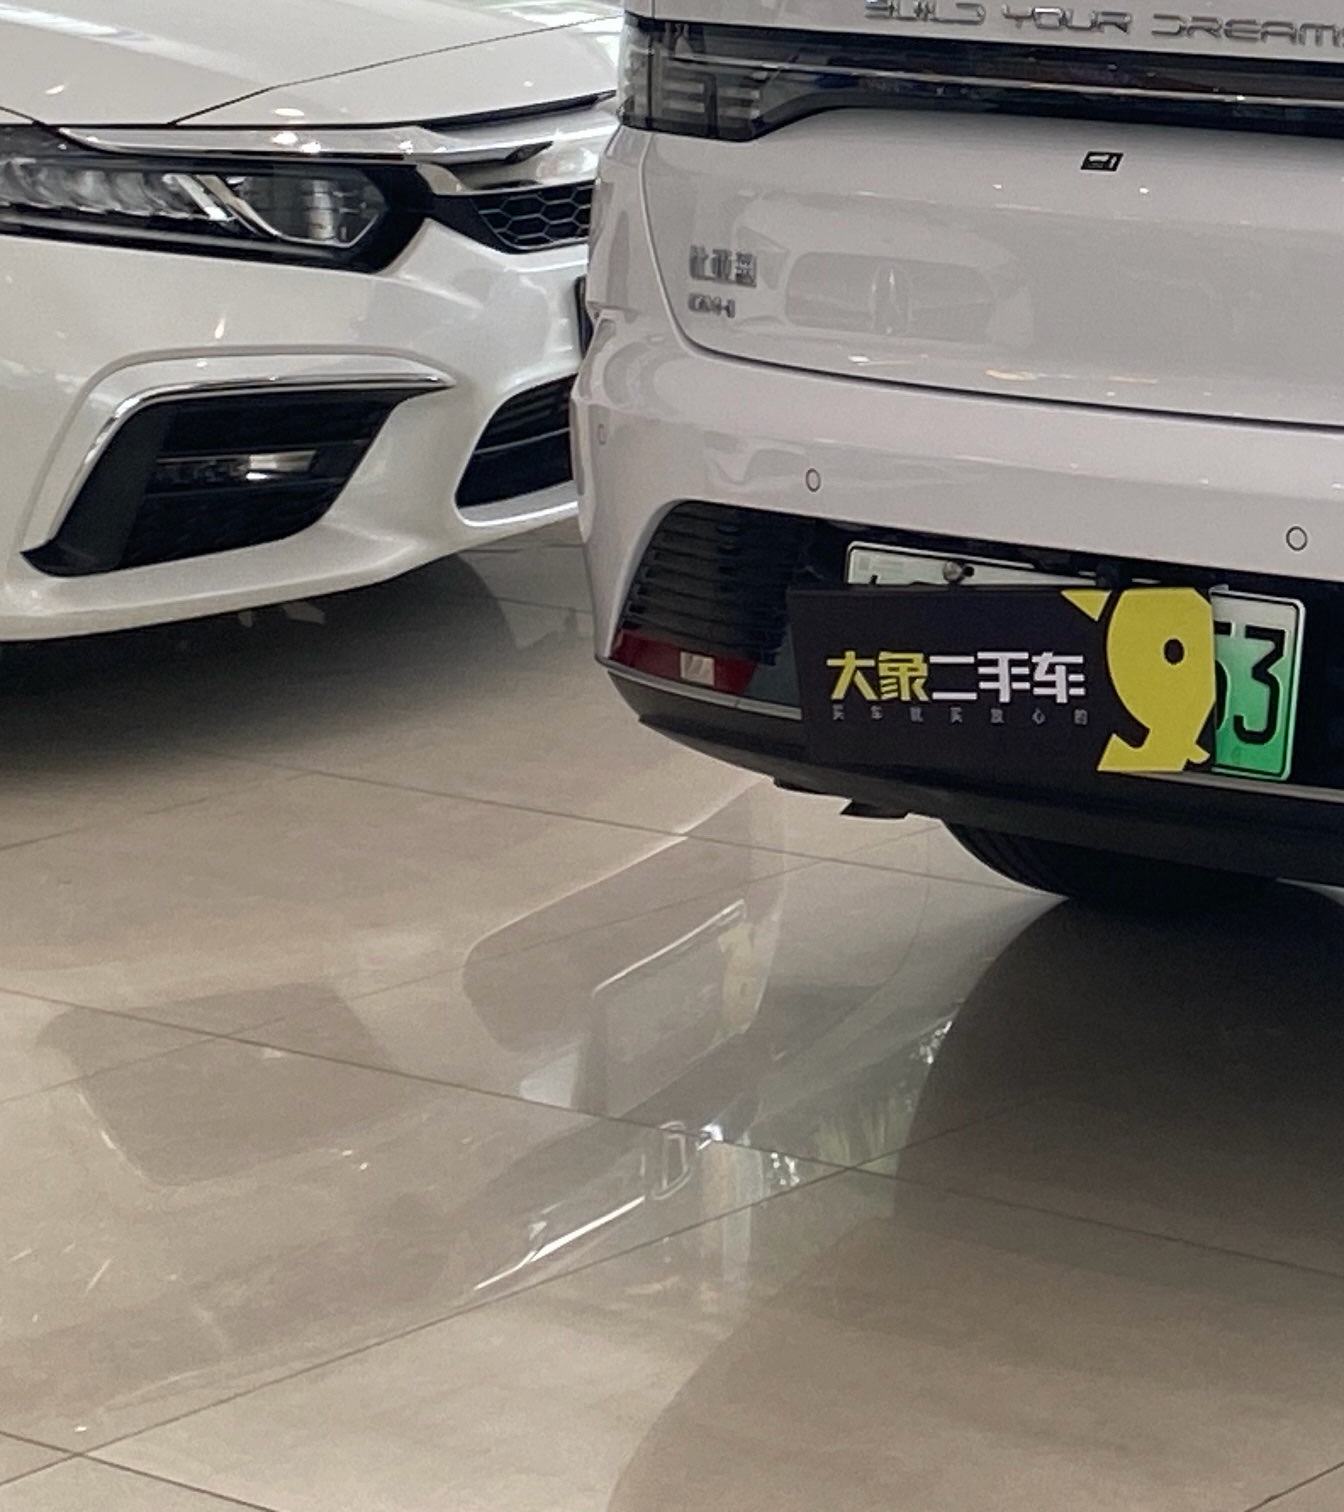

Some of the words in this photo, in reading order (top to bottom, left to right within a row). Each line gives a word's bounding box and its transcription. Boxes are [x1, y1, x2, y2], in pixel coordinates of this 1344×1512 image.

[1002, 4, 1133, 36] YOUR
[825, 649, 1087, 705] 大象二手车
